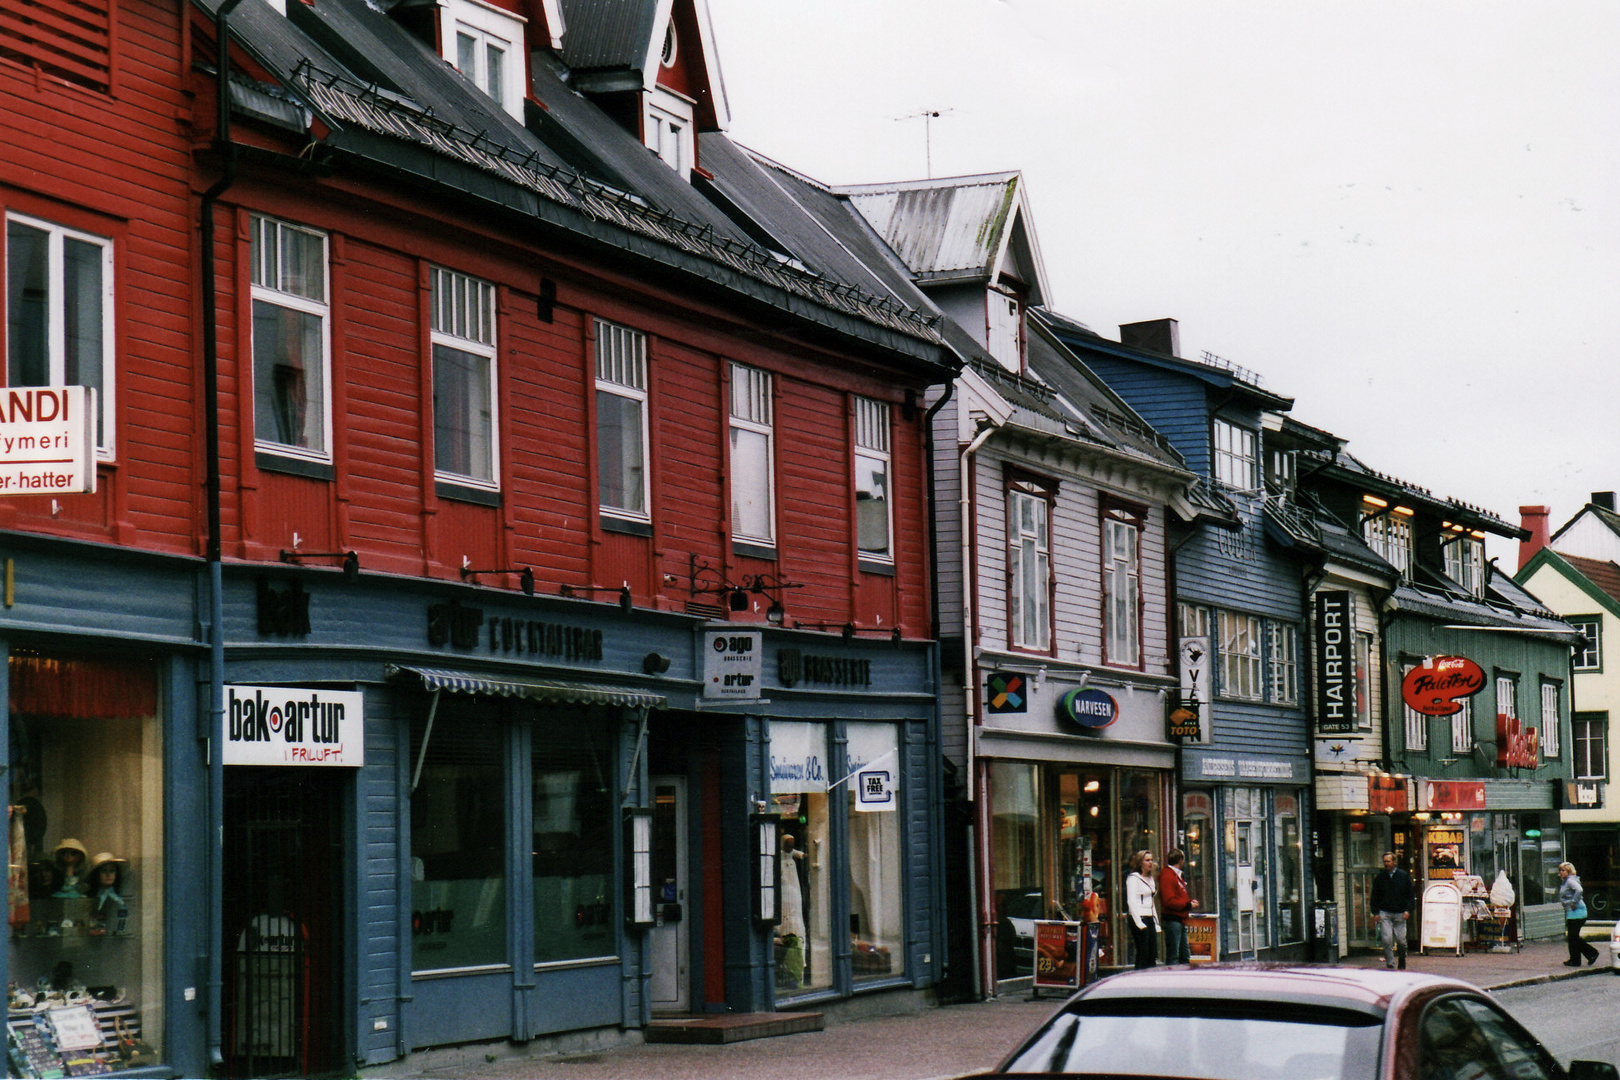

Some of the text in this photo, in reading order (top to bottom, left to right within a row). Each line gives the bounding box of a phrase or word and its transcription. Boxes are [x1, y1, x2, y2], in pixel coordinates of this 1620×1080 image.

[0, 390, 68, 423] NDI
[0, 431, 68, 453] ymeri
[1324, 598, 1344, 718] HAIRPORT
[724, 673, 754, 686] artur
[1414, 672, 1480, 695] Paletten
[229, 688, 345, 743] bak artur
[1075, 699, 1111, 717] NARVESEN
[1171, 727, 1197, 735] TOTO
[292, 743, 343, 762] FRILUFT!
[1428, 832, 1463, 844] KEBAB
